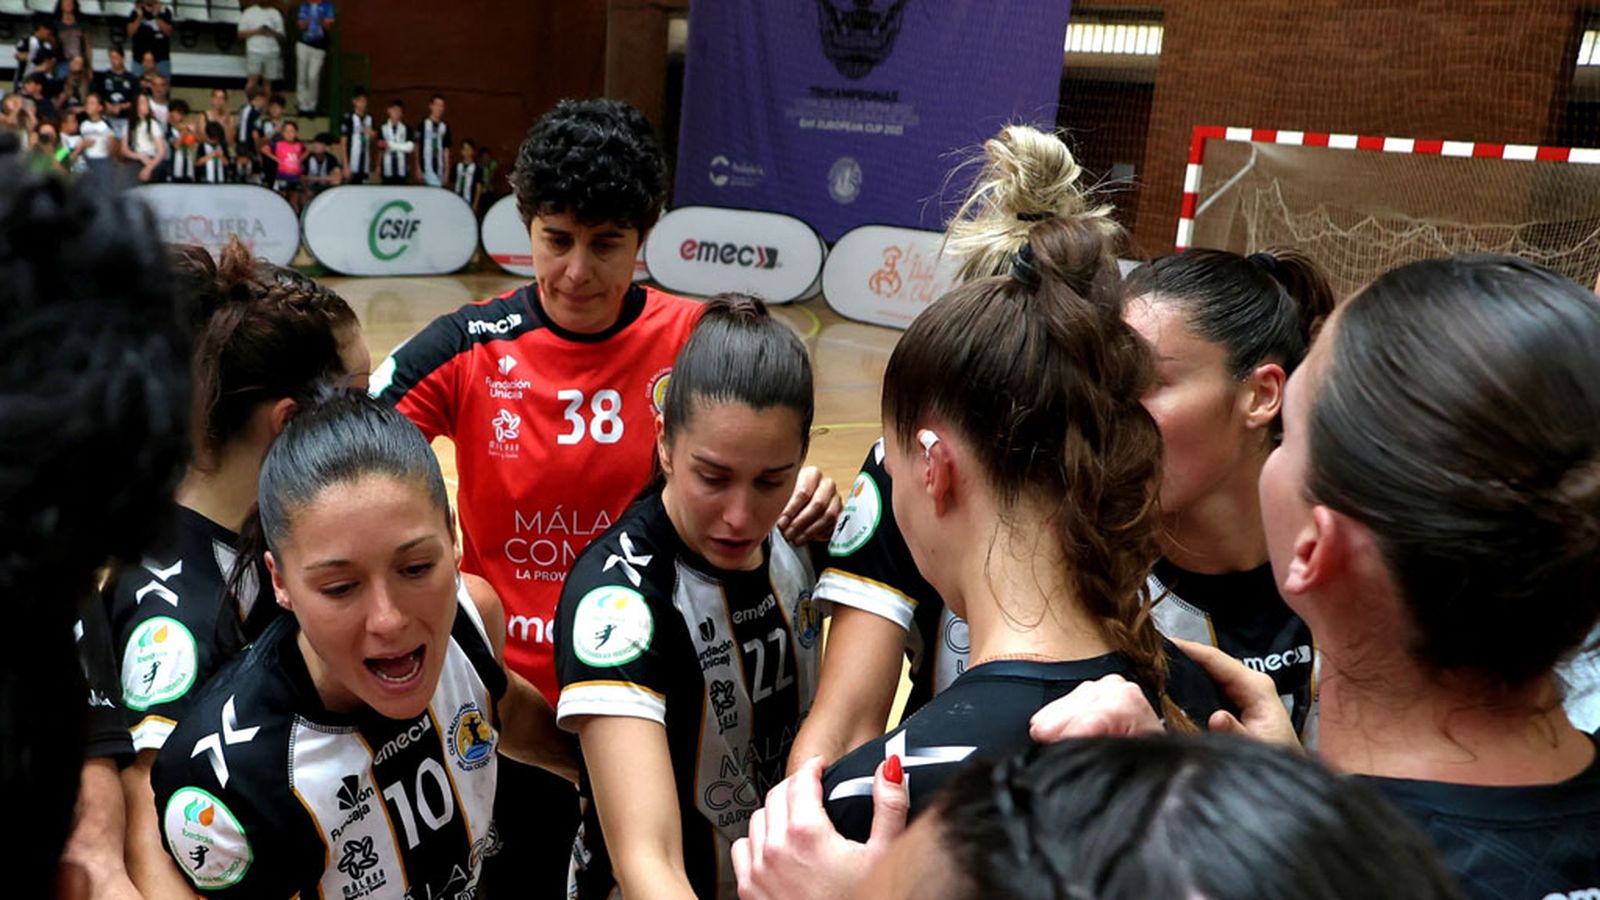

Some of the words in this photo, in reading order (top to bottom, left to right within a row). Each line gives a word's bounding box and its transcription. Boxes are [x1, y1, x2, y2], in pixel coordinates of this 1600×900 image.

[379, 218, 421, 240] CSIF
[679, 238, 755, 267] emec
[557, 389, 625, 445] 38
[515, 504, 612, 535] MÁLA
[515, 568, 531, 580] LA
[533, 570, 567, 582] PROV
[743, 627, 794, 704] 22
[1243, 649, 1295, 673] mec
[383, 756, 454, 851] 10
